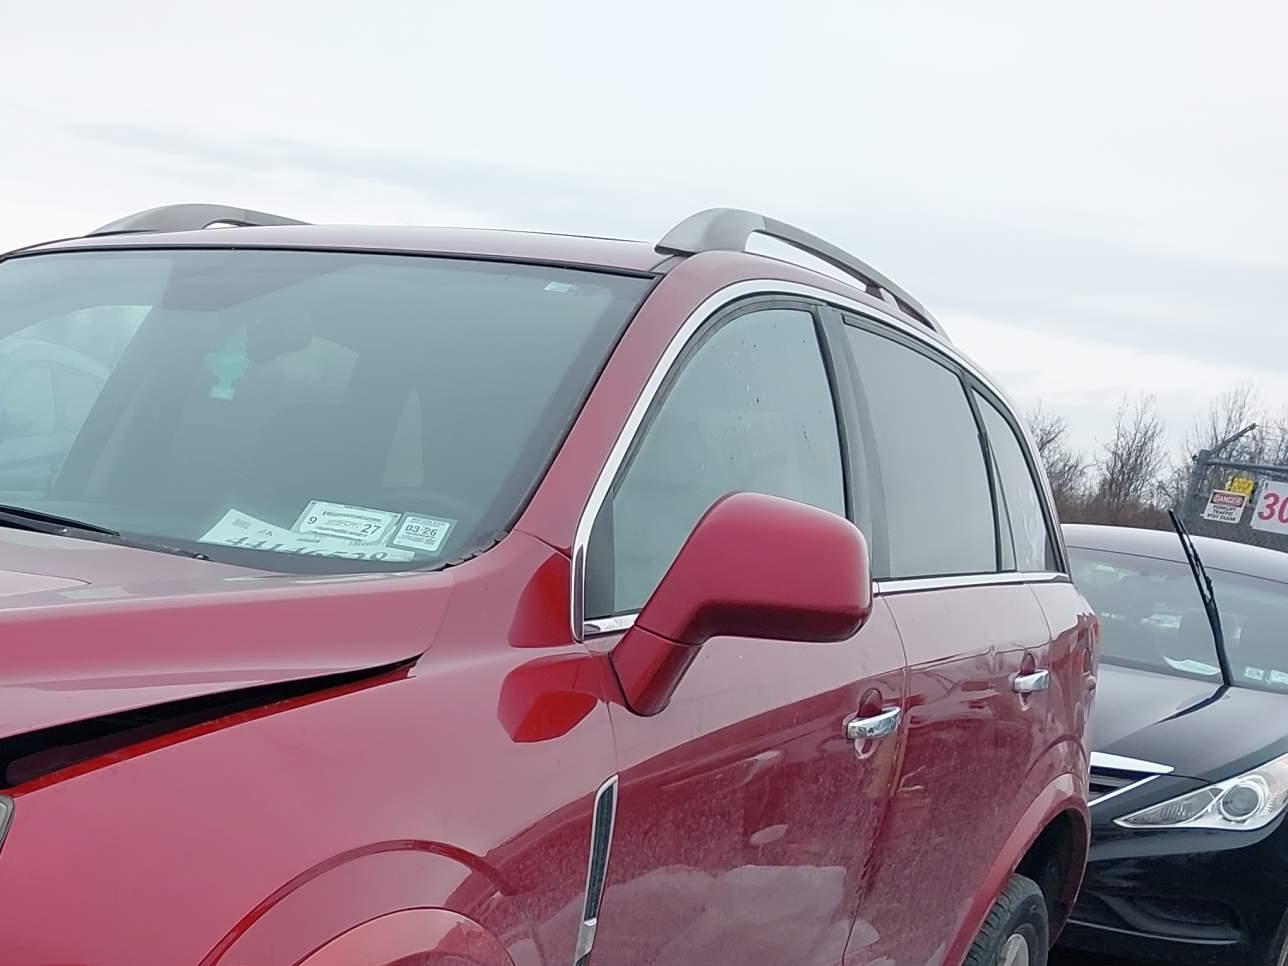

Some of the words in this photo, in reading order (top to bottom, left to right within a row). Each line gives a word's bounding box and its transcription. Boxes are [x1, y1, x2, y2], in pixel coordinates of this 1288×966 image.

[1214, 494, 1242, 505] DANGER
[307, 516, 318, 525] 9
[360, 523, 381, 535] 27
